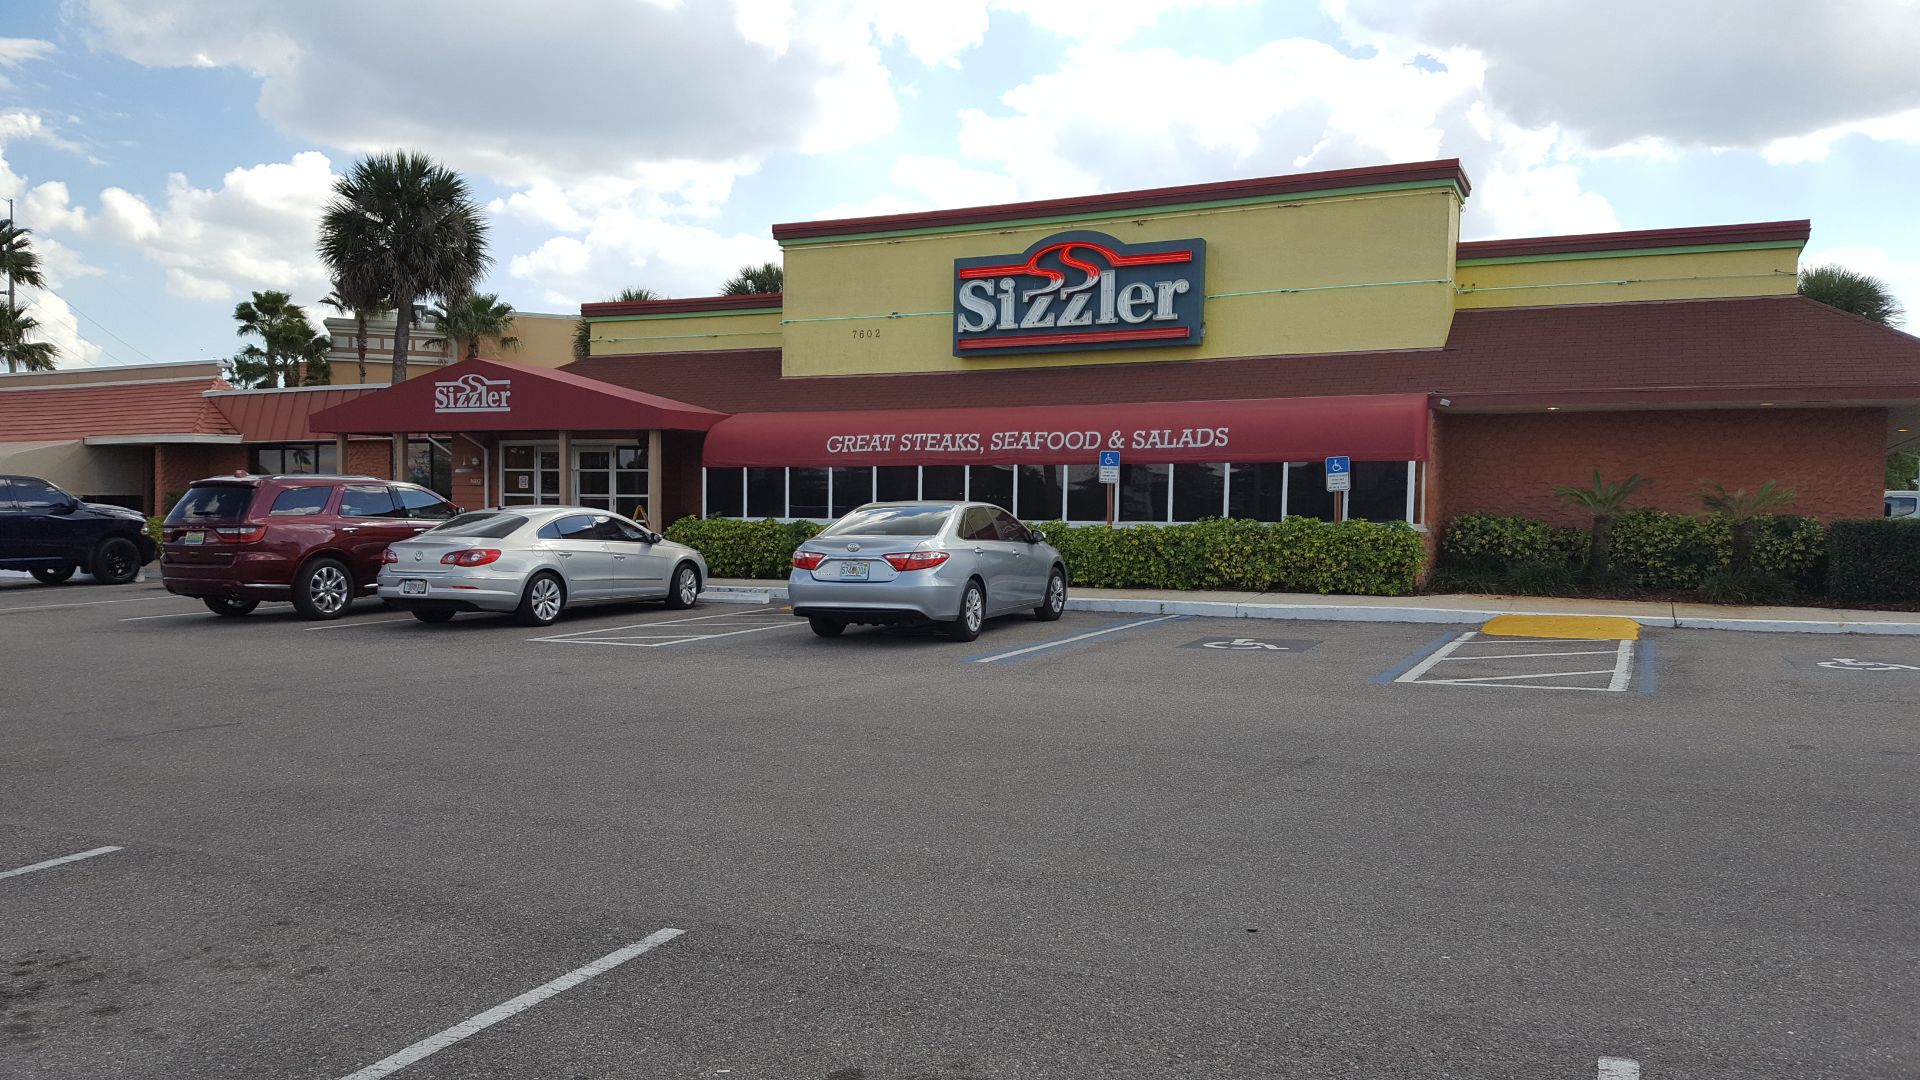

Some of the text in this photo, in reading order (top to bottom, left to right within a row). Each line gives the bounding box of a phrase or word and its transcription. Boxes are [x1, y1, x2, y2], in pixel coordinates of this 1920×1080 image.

[958, 250, 1190, 333] Sizzler
[852, 329, 880, 339] 7602
[435, 379, 511, 409] Sizzler
[826, 427, 1229, 454] GREAT STEAKS, SEAFOOD & SALADS
